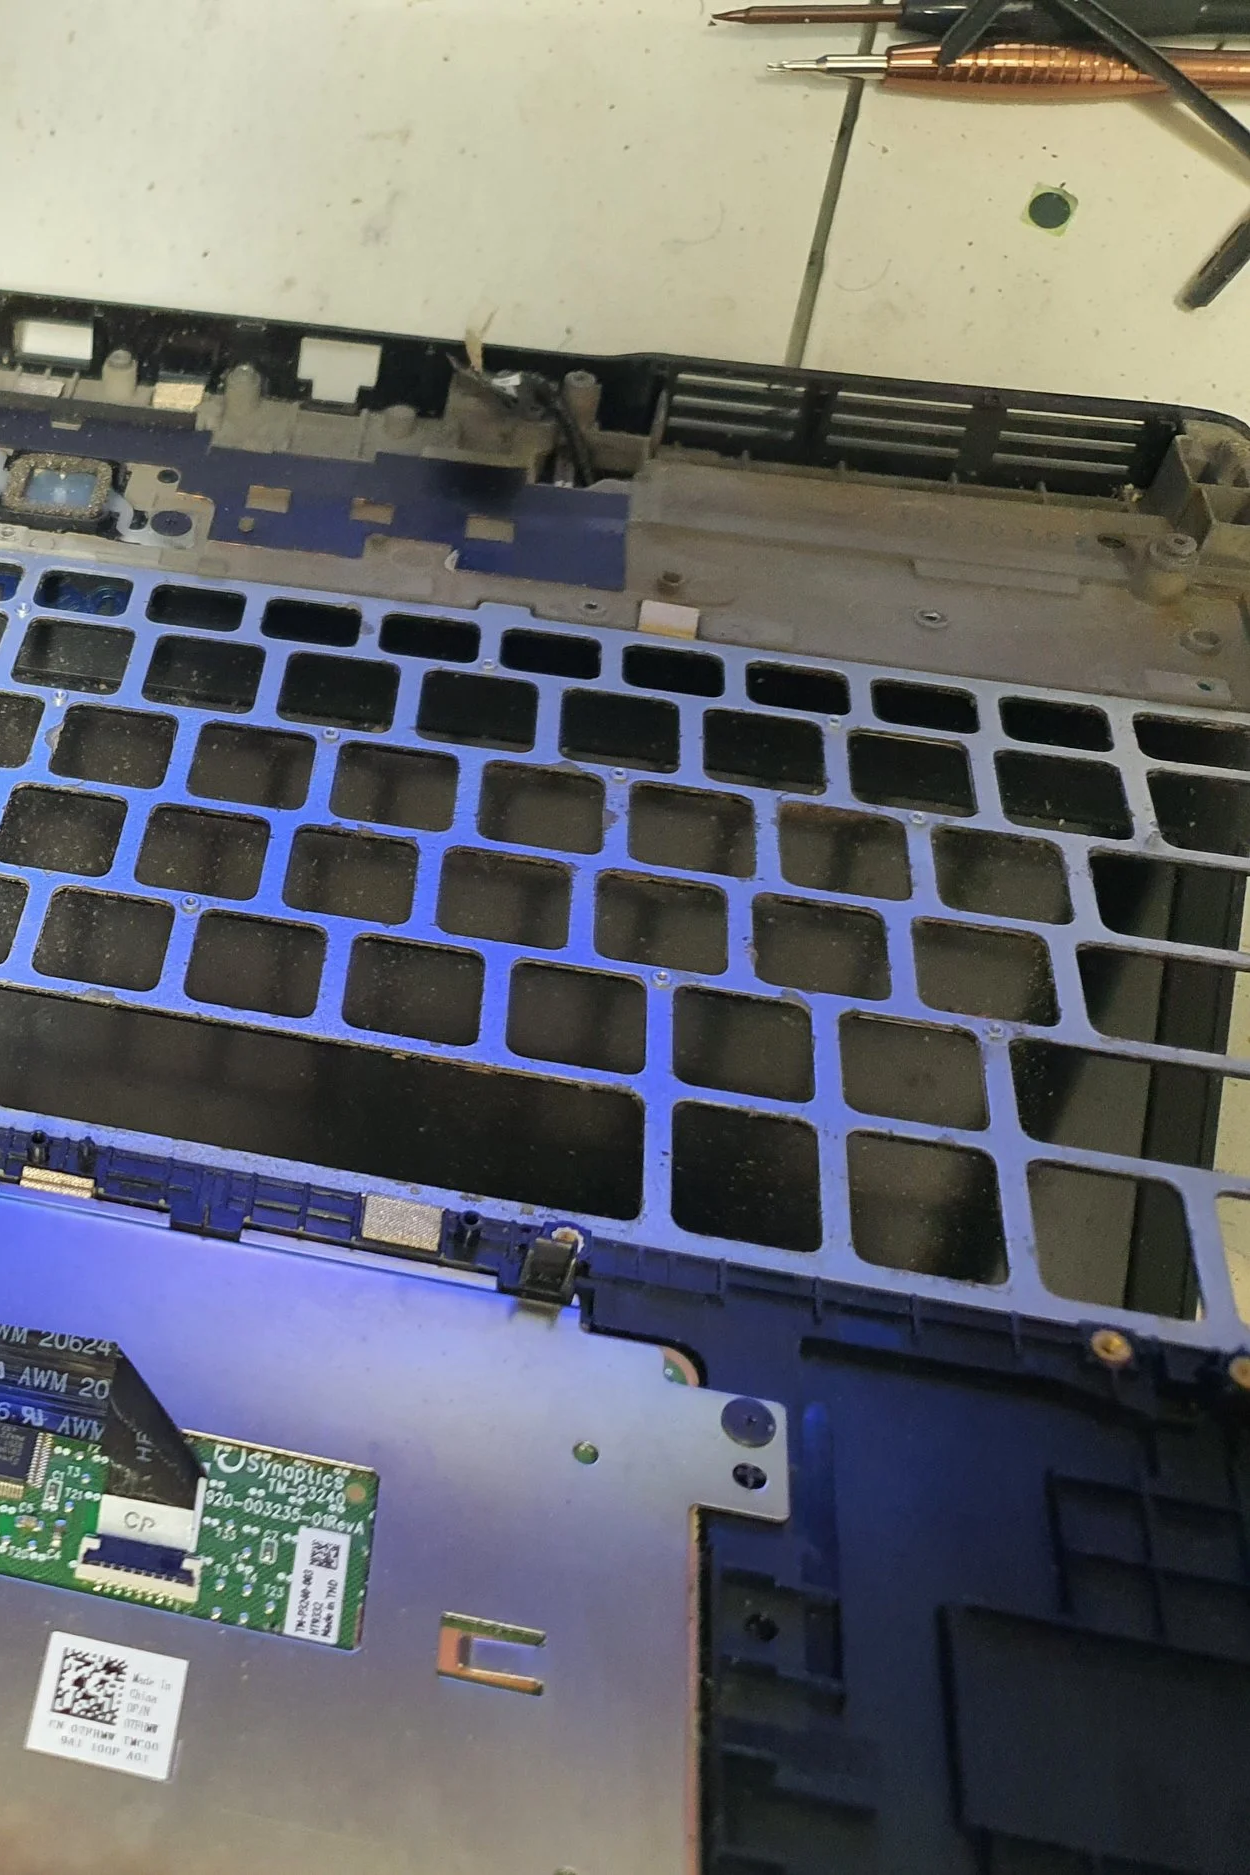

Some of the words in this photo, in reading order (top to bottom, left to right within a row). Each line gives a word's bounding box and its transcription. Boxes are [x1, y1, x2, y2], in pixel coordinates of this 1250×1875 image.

[18, 1367, 70, 1393] AWM
[247, 1453, 345, 1491] Synaptics
[267, 1477, 346, 1506] TM-P3240
[124, 1511, 156, 1532] CP
